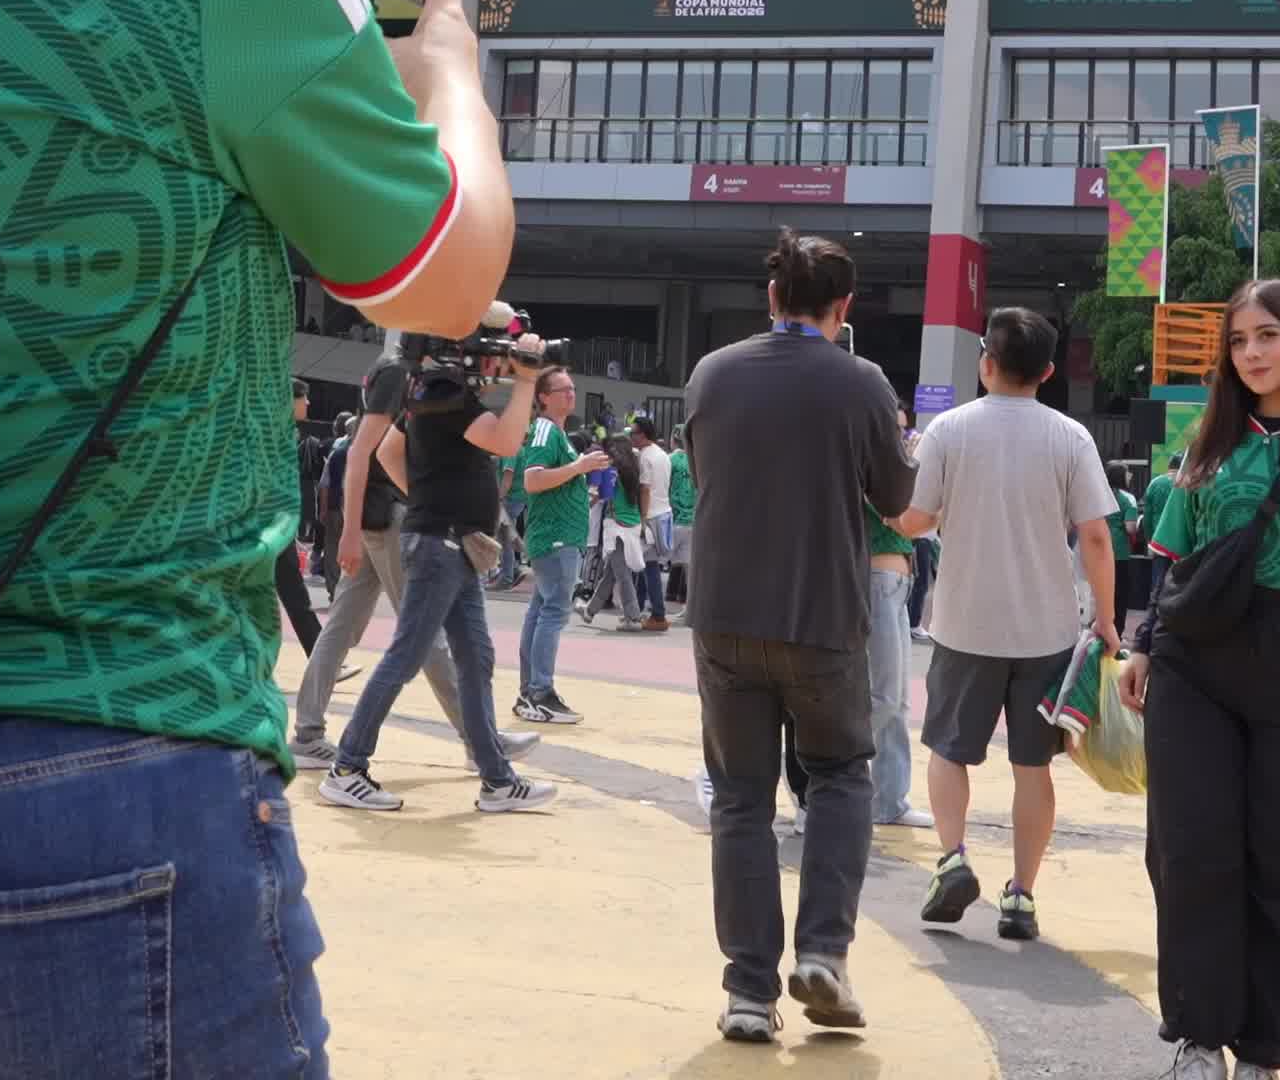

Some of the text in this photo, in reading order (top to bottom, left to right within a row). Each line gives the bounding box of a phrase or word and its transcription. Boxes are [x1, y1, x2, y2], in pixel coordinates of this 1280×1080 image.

[675, 7, 765, 16] DE LA FIFA 2026
[704, 173, 718, 193] 4
[1089, 177, 1104, 198] 4
